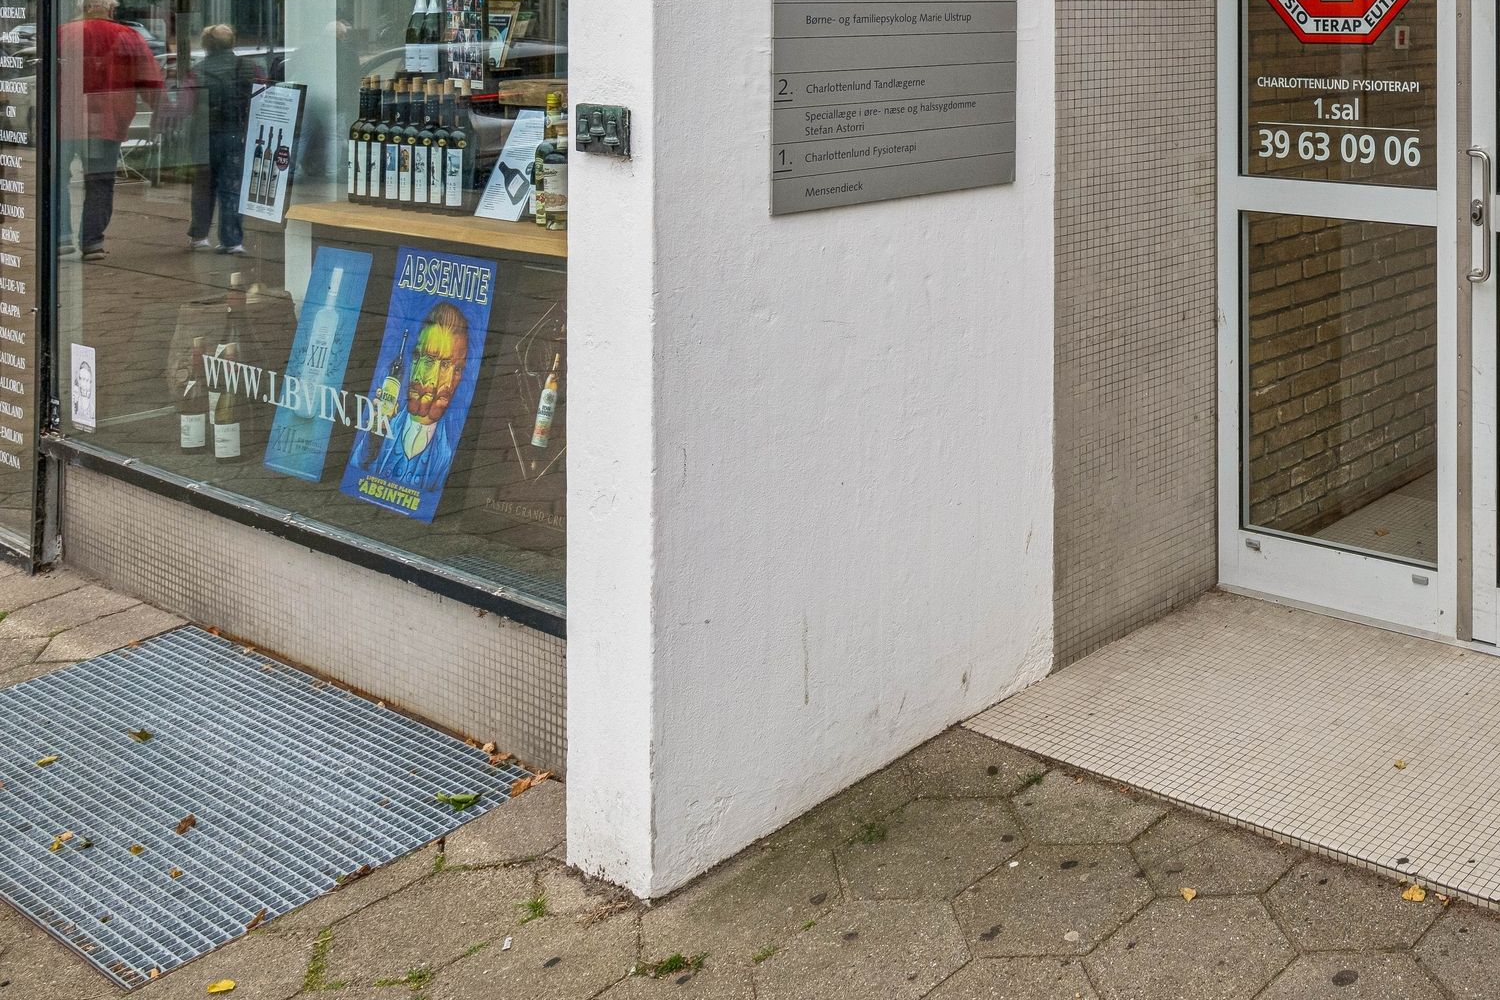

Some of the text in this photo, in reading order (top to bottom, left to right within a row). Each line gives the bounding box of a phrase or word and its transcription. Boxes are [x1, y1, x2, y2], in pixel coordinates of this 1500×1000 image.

[806, 13, 971, 26] Børne- og familiepsykolog Marie Ulstrup
[1314, 18, 1362, 33] TERAP
[2, 32, 20, 44] PASTIS
[0, 57, 23, 69] ABSENTE
[778, 78, 925, 95] 2. Charlottenlund Tandlægerne
[1257, 77, 1419, 92] CHARLOTTENLUND FYSIOTERAPI
[6, 105, 16, 118] GIN
[806, 100, 976, 122] Speciallæge øre- næse og halssygdomme
[1313, 98, 1359, 121] 1.sal
[805, 122, 864, 136] Stefan Astorri
[779, 143, 917, 165] 1. Charlottenlund Fysioterapi
[1259, 130, 1421, 167] 39 63 09 06
[1, 156, 22, 169] COGNAC
[805, 183, 863, 197] Mensendieck
[2, 227, 20, 243] RHÔNE
[0, 253, 21, 269] WHISKY
[398, 254, 491, 305] ABSENTE
[0, 303, 20, 319] GRAPPA
[203, 355, 394, 440] WWW.LBVIN.DK
